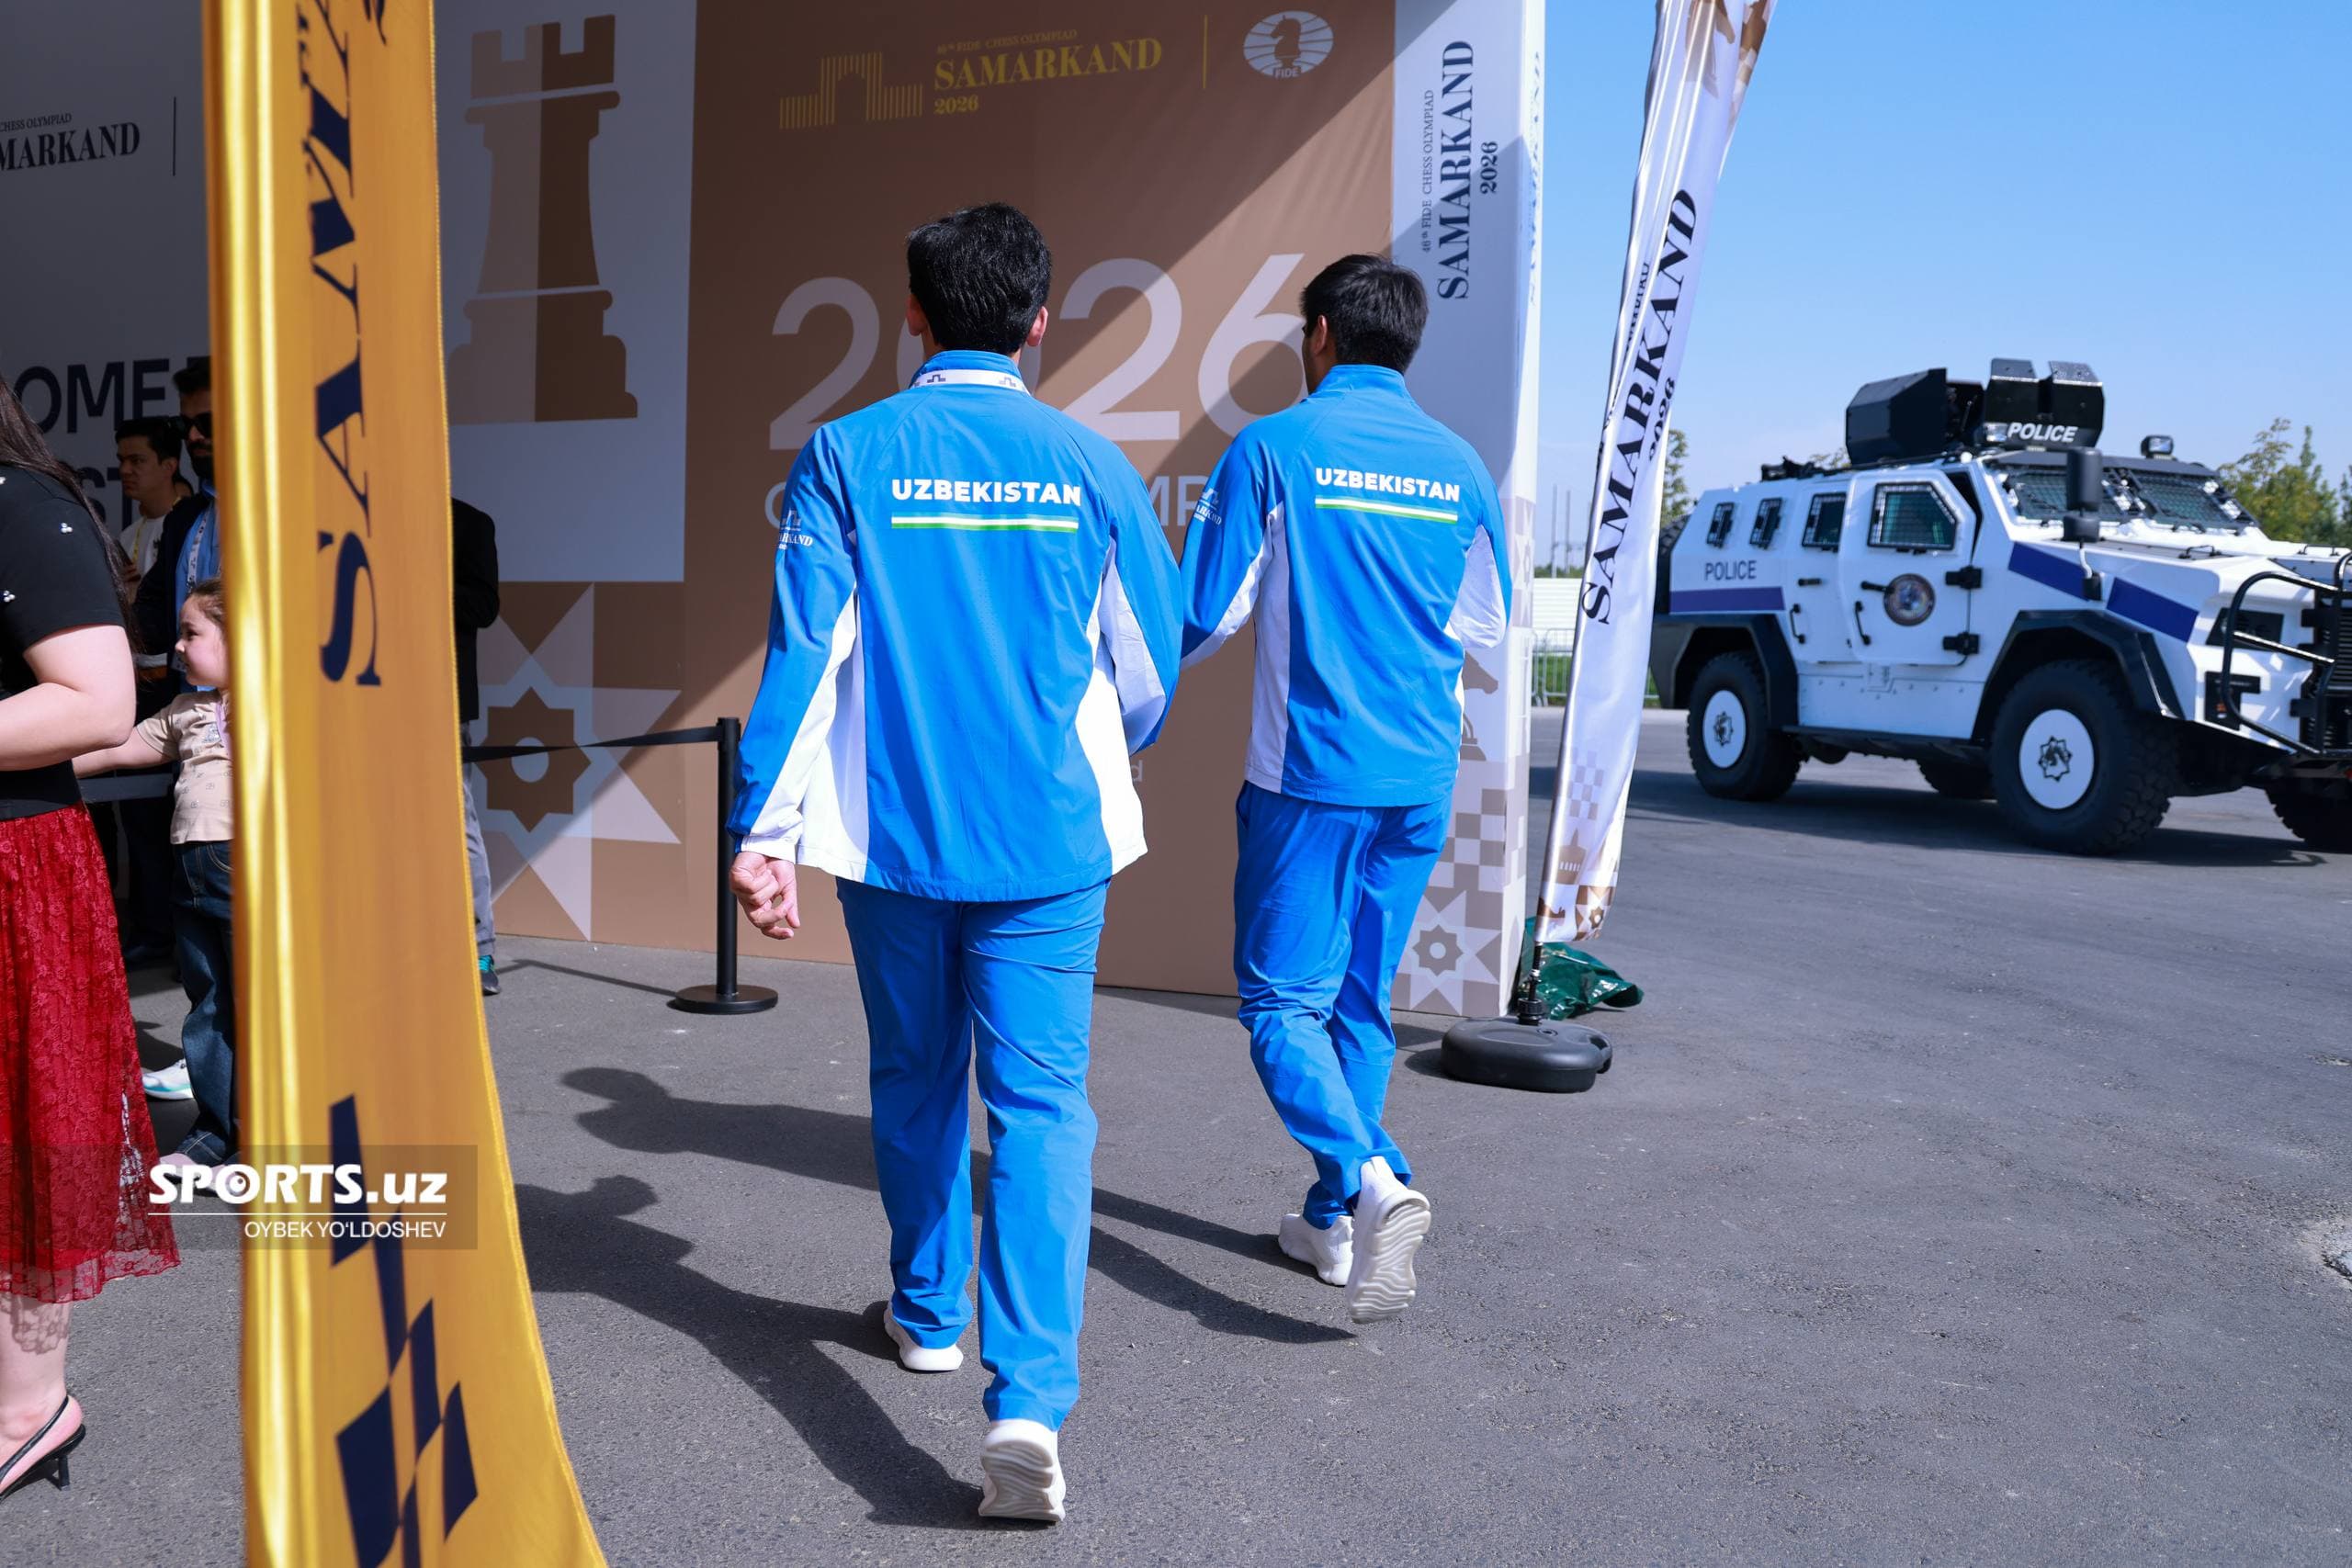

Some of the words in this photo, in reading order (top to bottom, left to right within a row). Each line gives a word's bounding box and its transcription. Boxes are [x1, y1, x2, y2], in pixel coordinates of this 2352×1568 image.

[1020, 28, 1078, 44] OLYMPIAD
[934, 37, 1162, 91] SAMARKAND
[26, 113, 73, 129] OLYMPIAD
[933, 95, 979, 115] 2026
[1424, 90, 1434, 152] OLYMPIAD
[1423, 157, 1433, 195] CHESS
[1437, 40, 1474, 299] SAMARKAND
[1480, 141, 1498, 195] 2026
[1422, 198, 1432, 229] FIDE
[769, 253, 1307, 450] 226
[1582, 189, 1697, 625] SAMARKAND
[2007, 422, 2078, 443] POLICE
[891, 479, 1081, 507] UZBEKISTAN
[1315, 467, 1460, 502] UZBEKISTAN
[1704, 560, 1758, 581] POLICE
